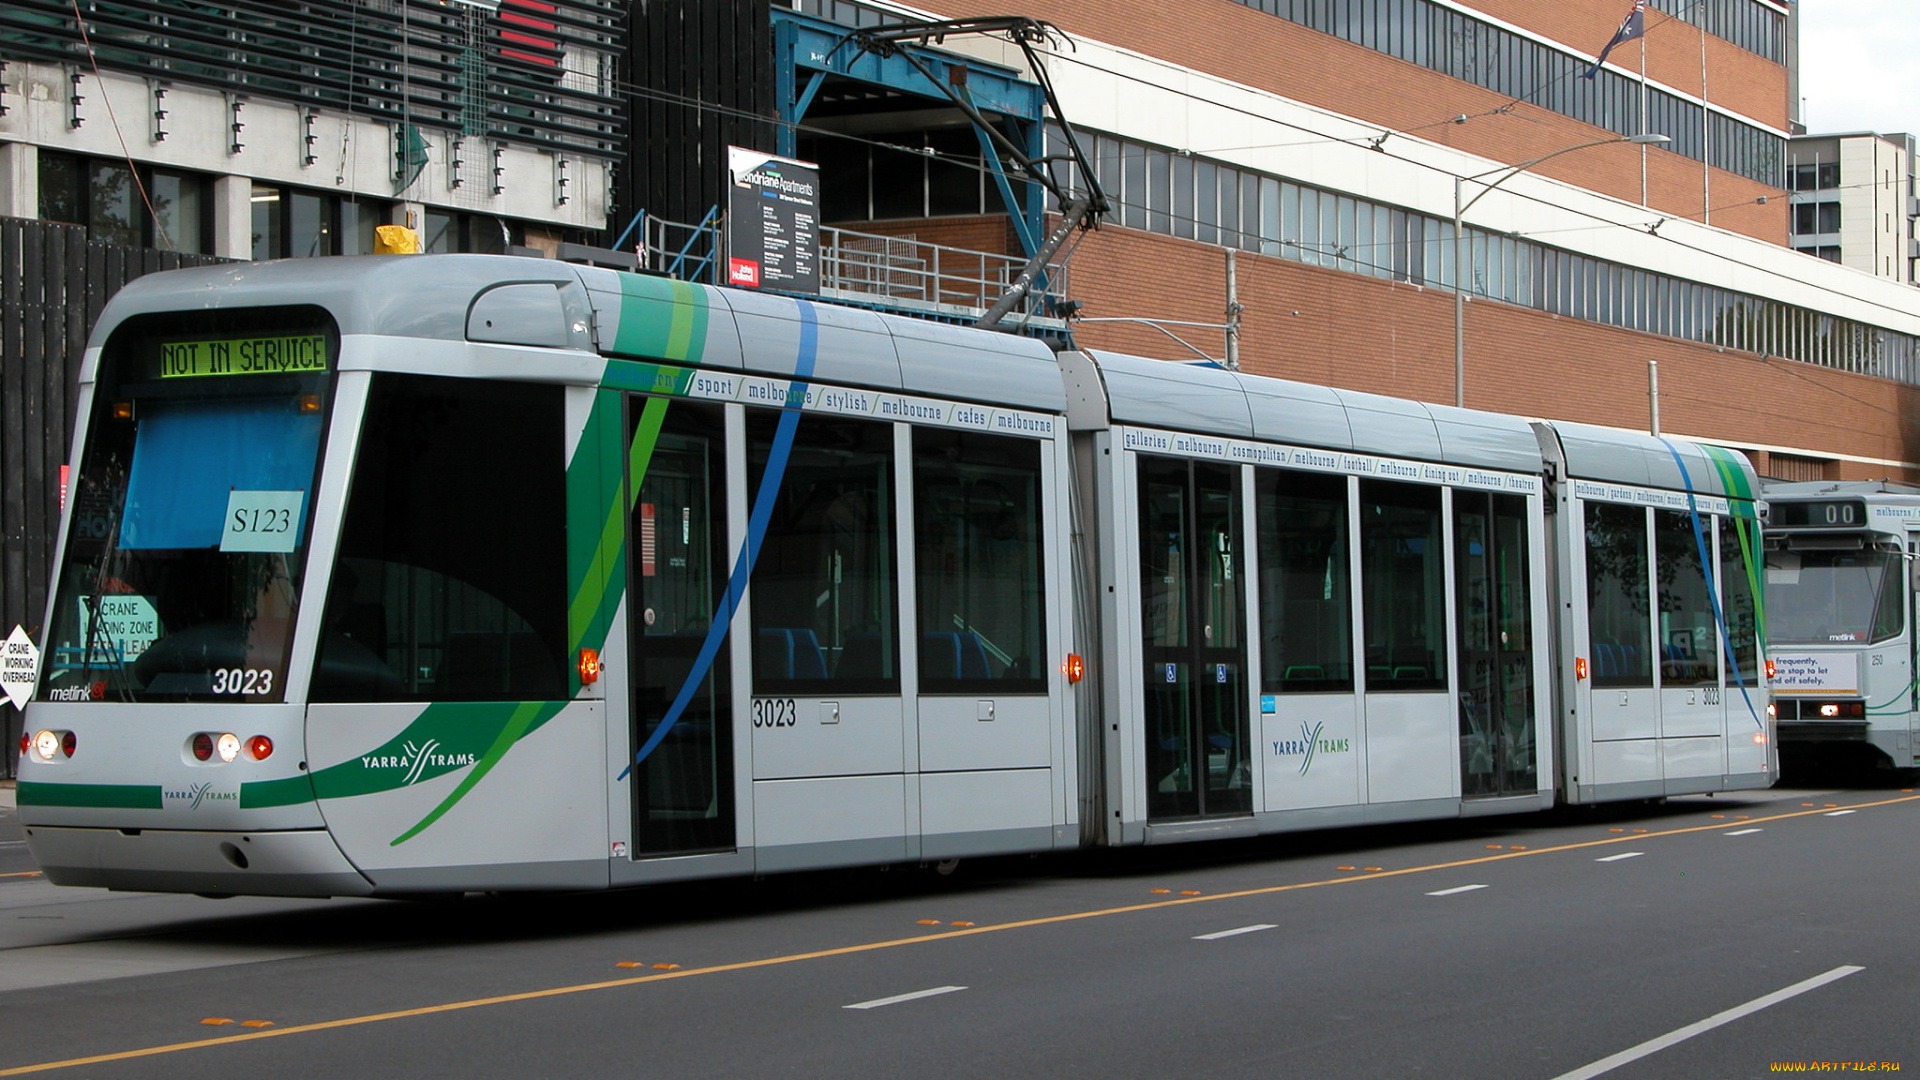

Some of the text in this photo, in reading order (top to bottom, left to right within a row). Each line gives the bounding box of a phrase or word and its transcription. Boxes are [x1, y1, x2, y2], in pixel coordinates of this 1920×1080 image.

[780, 177, 814, 197] Apartments
[163, 337, 324, 376] NOT IN SERVICE
[698, 377, 732, 396] sport
[749, 381, 812, 404] melbourne
[826, 391, 867, 413] stylish
[882, 398, 941, 420] melbourne
[957, 408, 985, 426] cafes
[998, 413, 1051, 432] melbourne
[1125, 431, 1535, 490] galleries melbourne cosmopolitan melbourne football melbourne dining out melbourne theatres
[1576, 482, 1605, 497] melbourne
[1876, 506, 1912, 518] melbourne
[231, 508, 290, 533] S123
[102, 602, 139, 616] CRANE
[84, 621, 153, 634] LADING ZONE
[1829, 633, 1856, 641] metlink
[9, 643, 29, 654] CRANE
[5, 657, 34, 669] WORKING
[1776, 657, 1818, 667] frequently.
[1872, 654, 1884, 666] 250
[3, 671, 36, 683] OVERHEAD
[1788, 667, 1805, 676] stop
[212, 668, 273, 695] 3023
[1799, 677, 1825, 686] safely.
[49, 682, 92, 701] metlink
[1702, 688, 1720, 706] 3023
[753, 699, 796, 728] 3023
[1273, 738, 1349, 756] YARRA TRAMS
[362, 753, 475, 768] YARRA TRAMS
[164, 791, 237, 800] YARRA TRAMS
